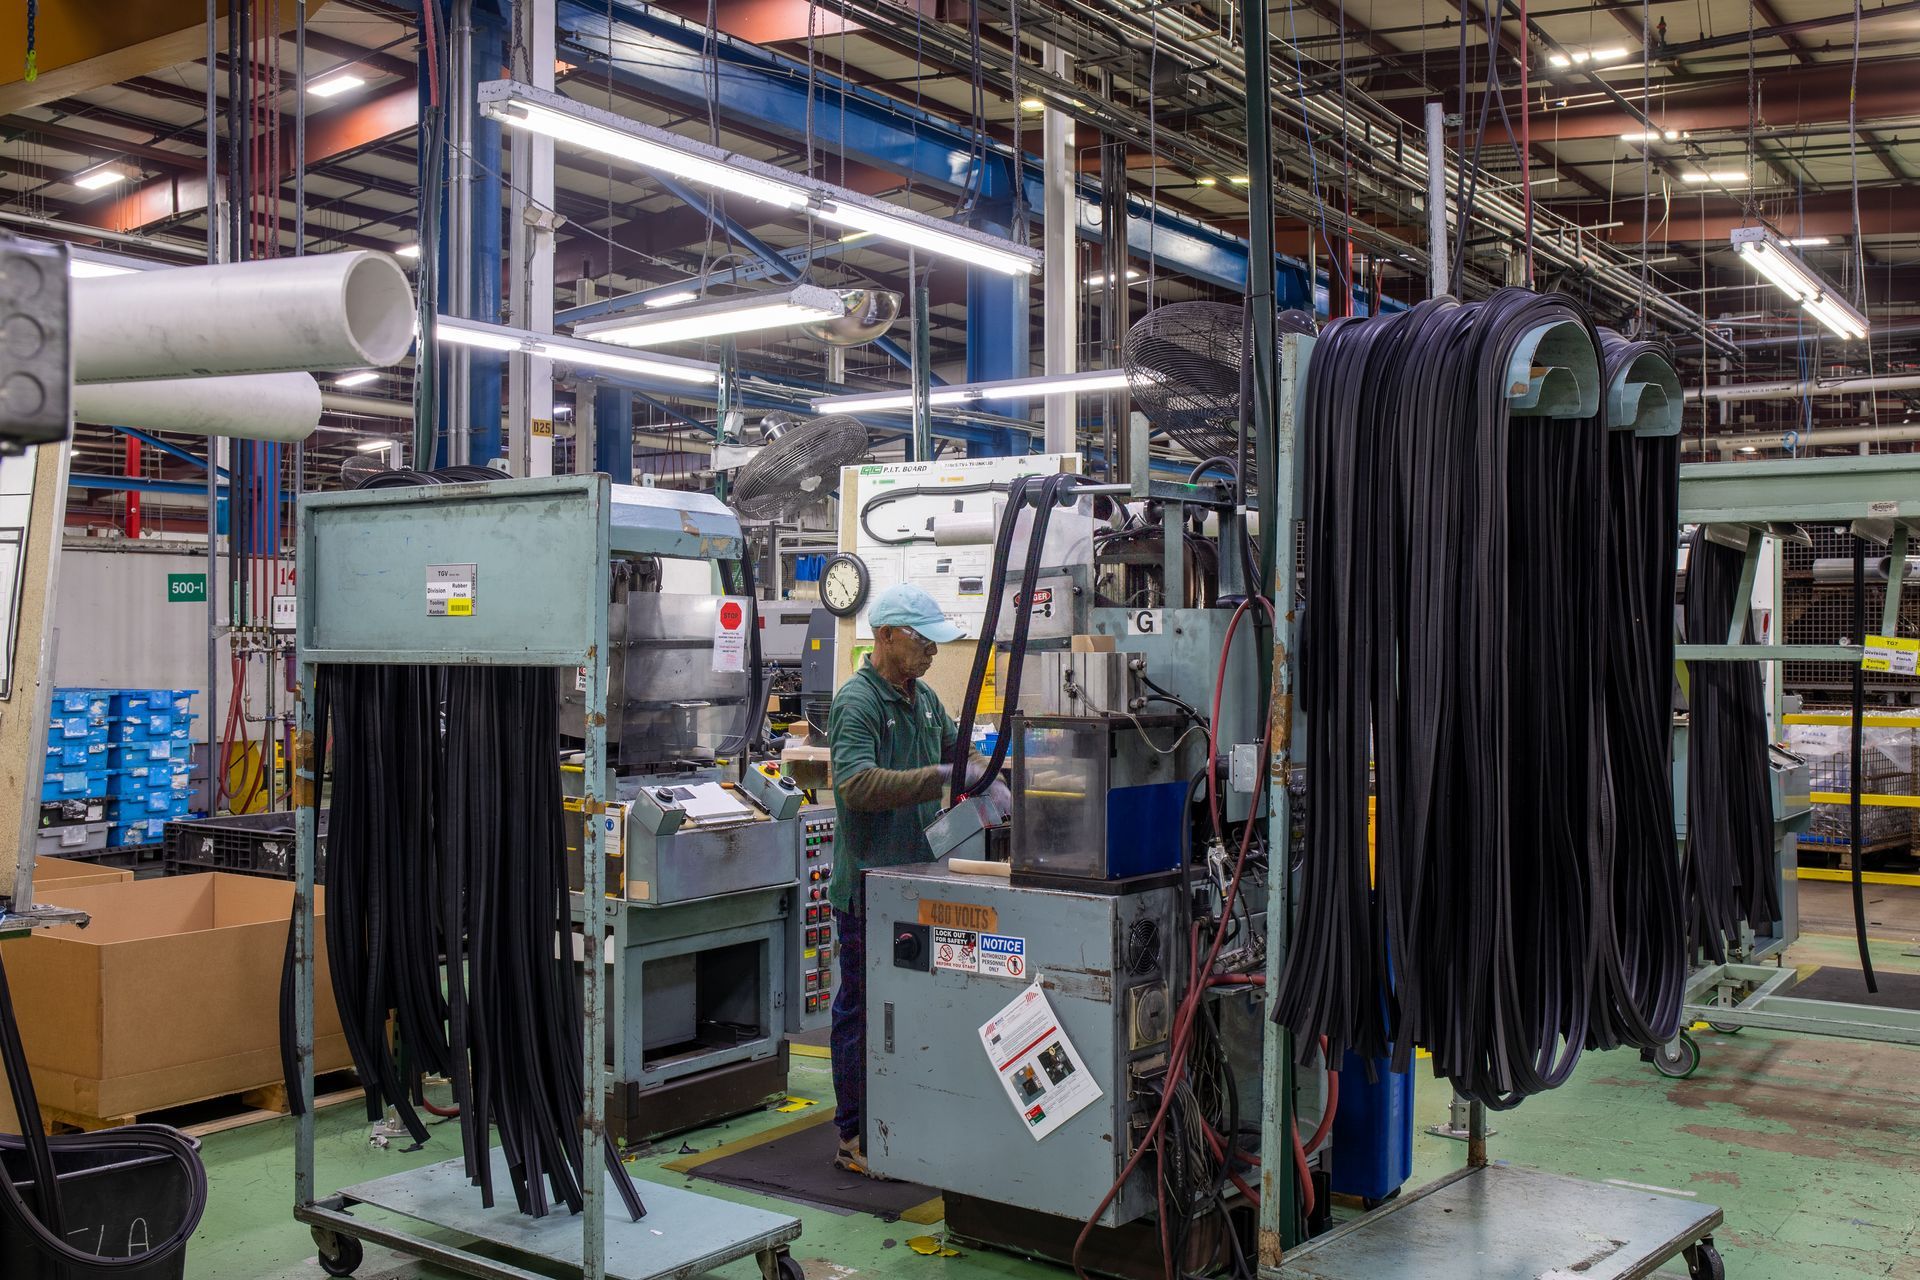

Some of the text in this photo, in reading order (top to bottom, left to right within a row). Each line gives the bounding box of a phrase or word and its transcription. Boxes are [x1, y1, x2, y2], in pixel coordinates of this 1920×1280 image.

[533, 421, 551, 434] D25
[1136, 610, 1154, 633] G
[931, 903, 988, 929] 480 VOLTS
[935, 929, 952, 938] LOCK
[982, 937, 1022, 952] NOTICE
[981, 952, 1007, 961] AUTHORIZED
[982, 958, 1006, 968] PERSONNEL
